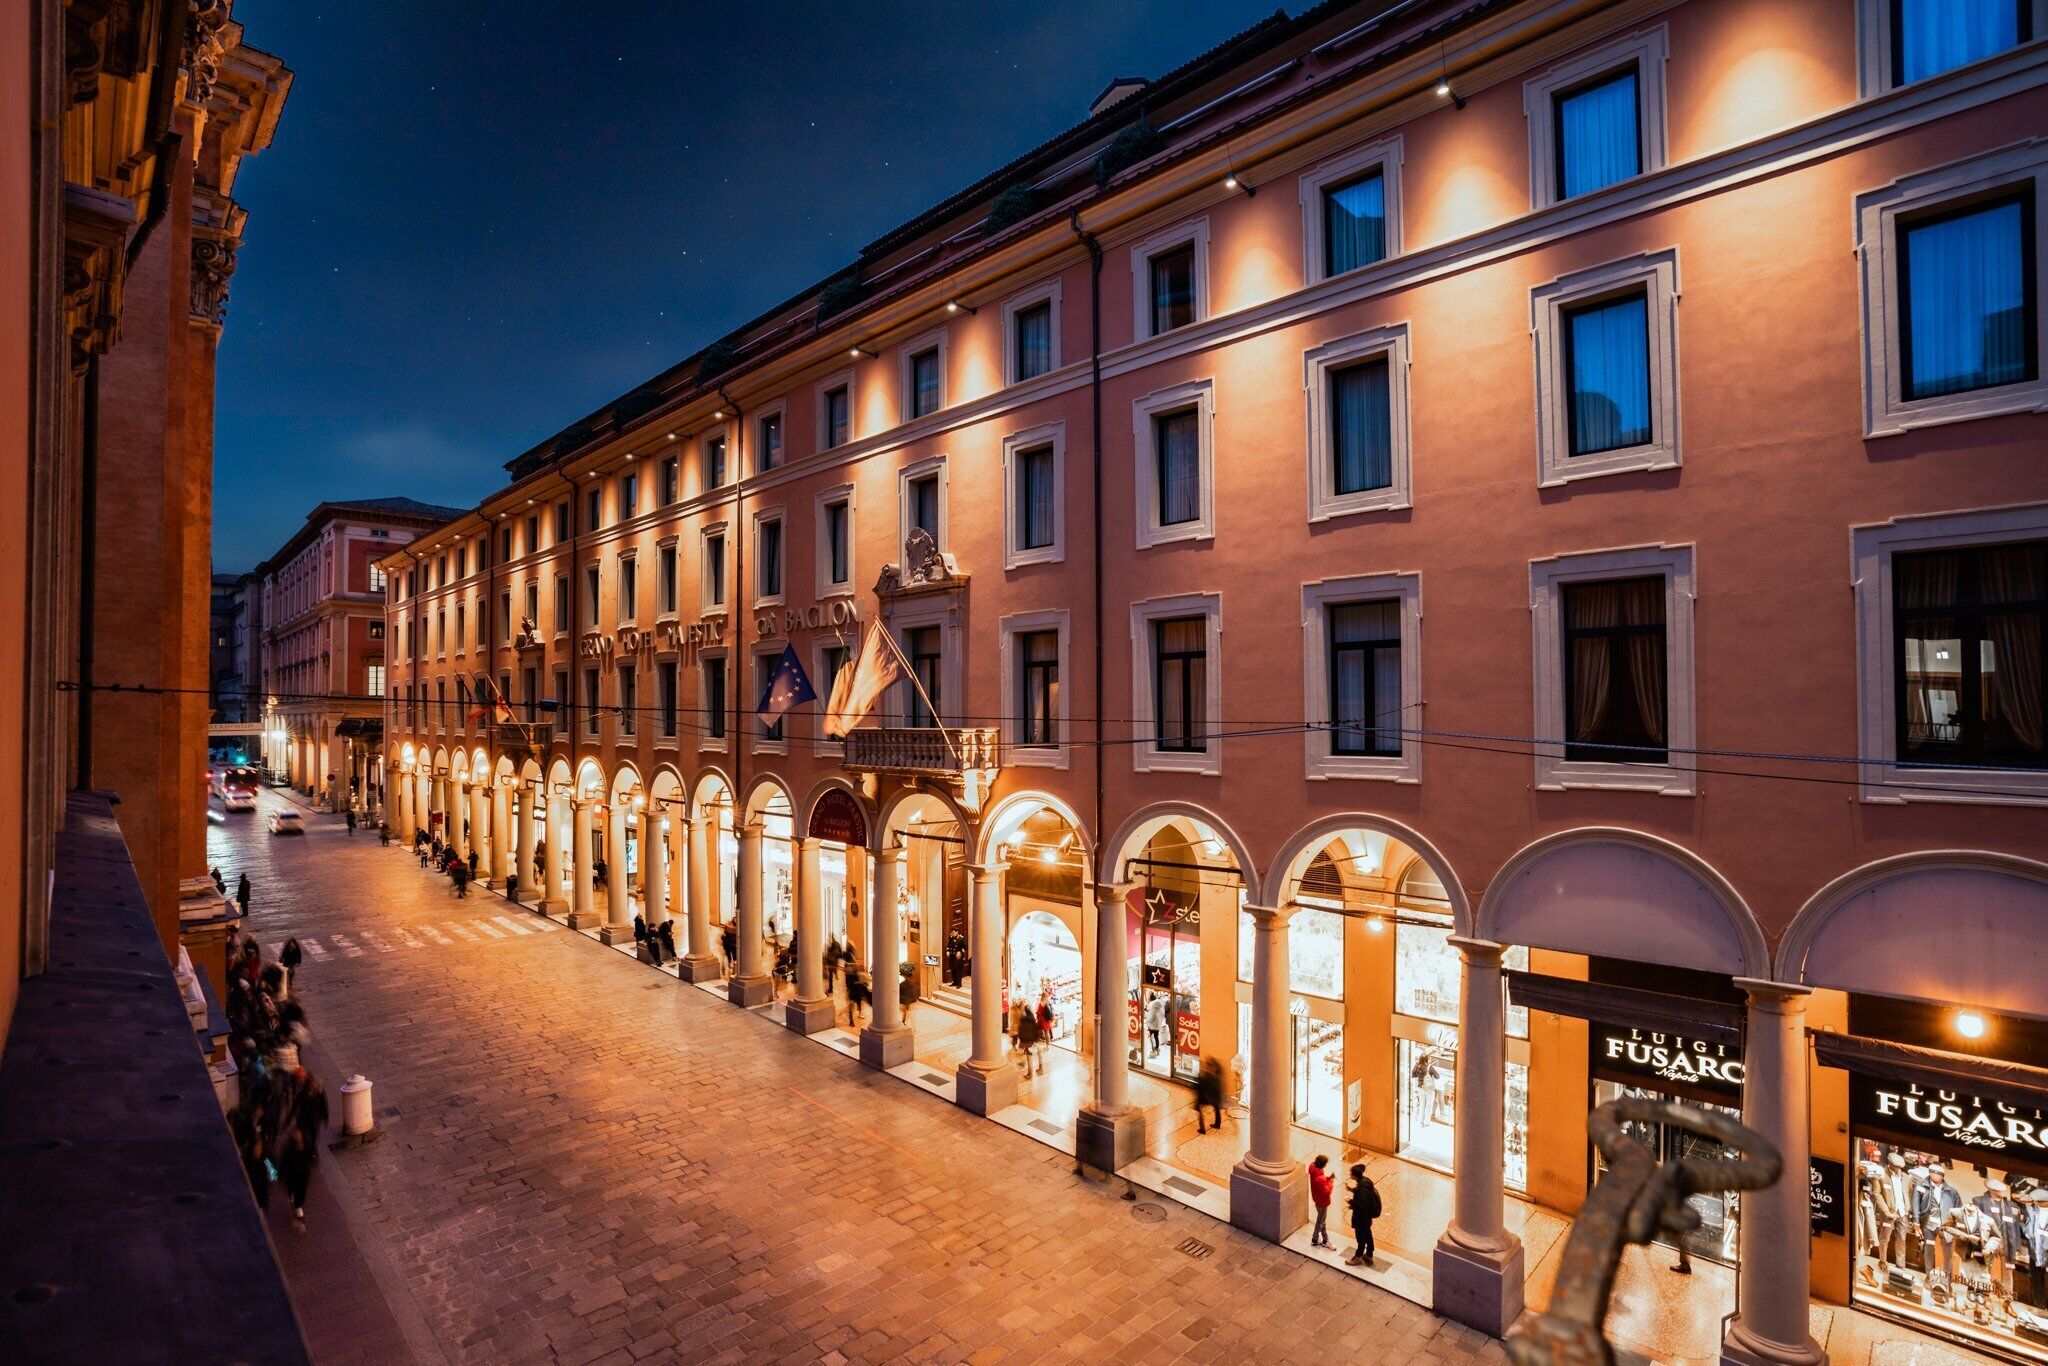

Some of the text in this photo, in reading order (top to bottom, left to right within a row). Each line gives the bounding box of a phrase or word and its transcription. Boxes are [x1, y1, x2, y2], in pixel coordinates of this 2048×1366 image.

[580, 634, 614, 656] GRAND
[623, 629, 656, 651] HOTEL
[667, 619, 724, 645] MAJESTIC
[826, 794, 846, 806] HOTEL
[1179, 1016, 1200, 1030] Saldi
[1631, 1028, 1725, 1057] LUIGI
[1655, 1067, 1700, 1083] Napoli
[1909, 1083, 2043, 1120] LUIGI
[1943, 1129, 2007, 1149] Napoli
